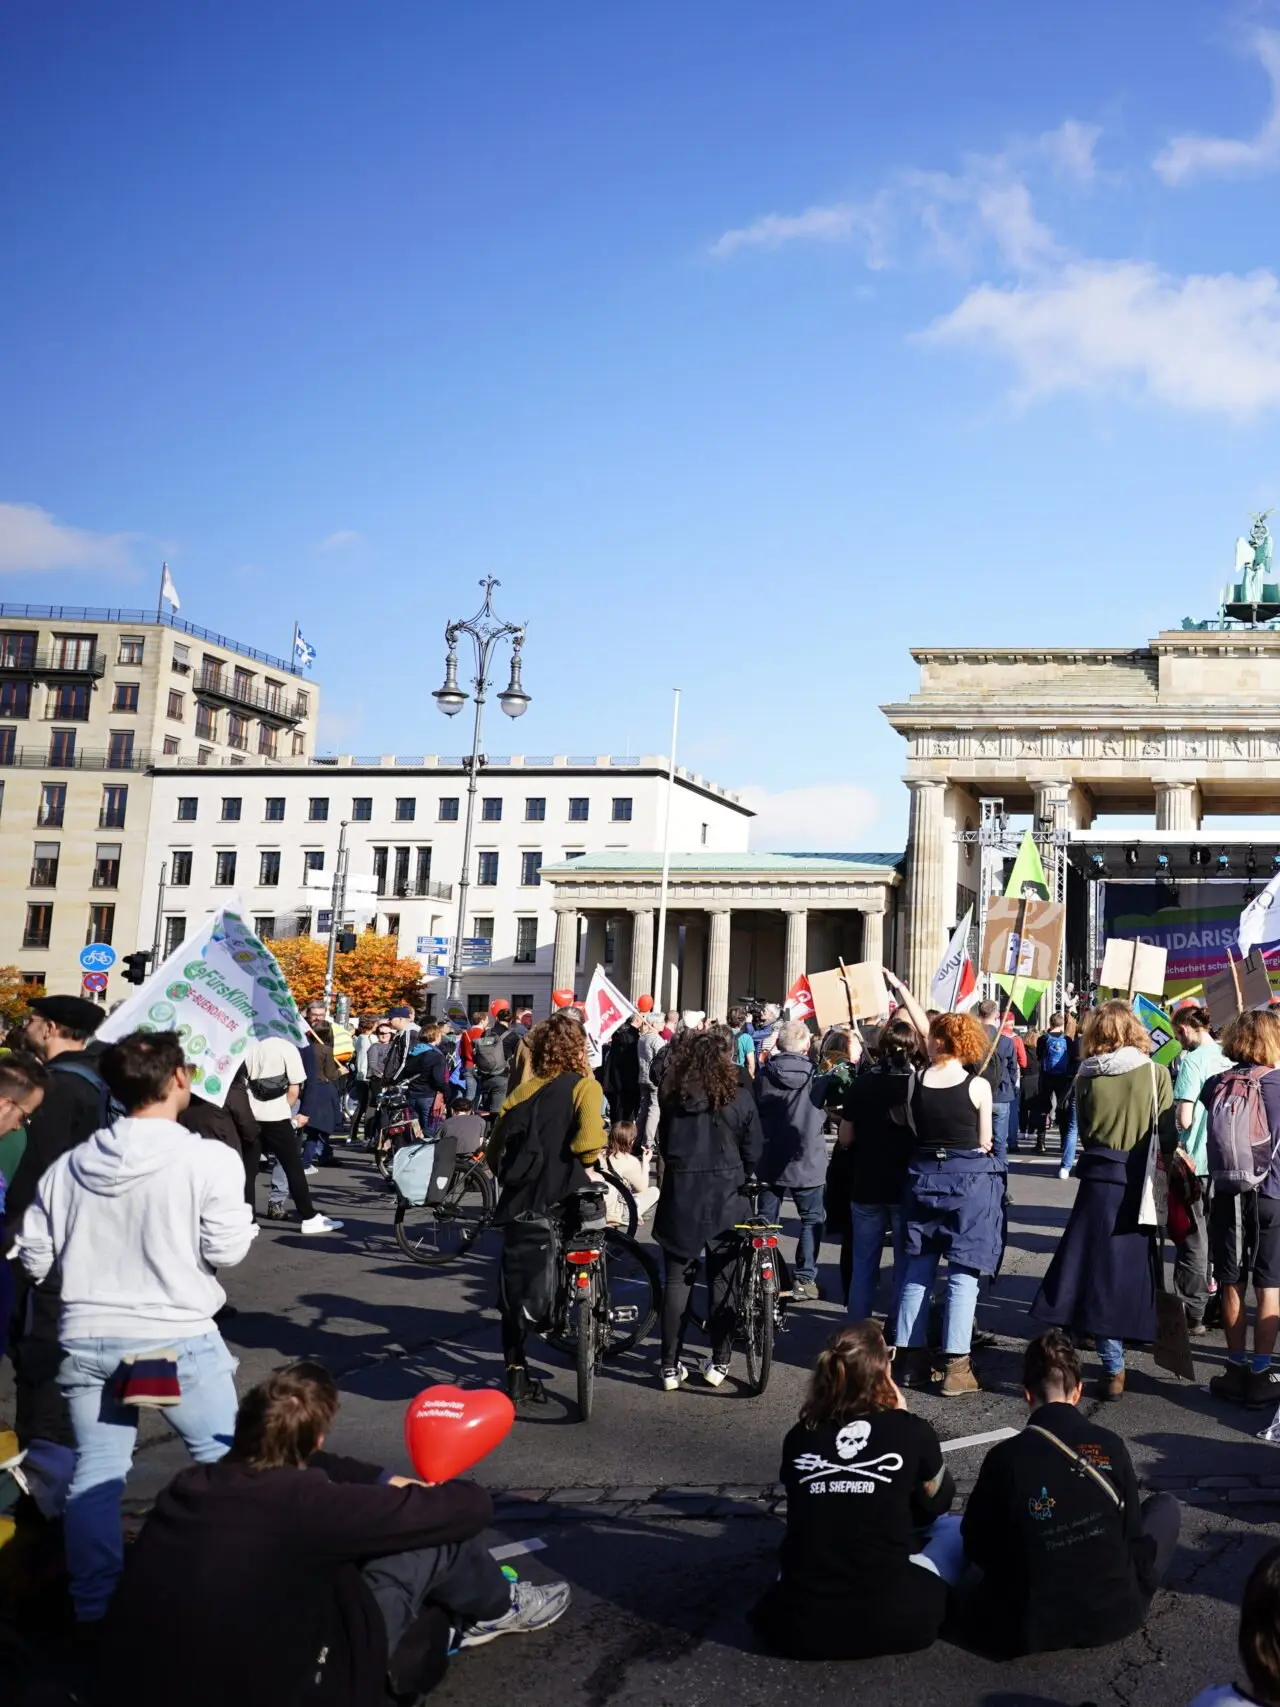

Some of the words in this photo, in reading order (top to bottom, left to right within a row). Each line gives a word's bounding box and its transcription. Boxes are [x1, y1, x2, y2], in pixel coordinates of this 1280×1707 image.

[423, 1400, 465, 1409] Solidarität
[809, 1481, 826, 1494] SEA
[829, 1480, 875, 1494] SHEPHERD
